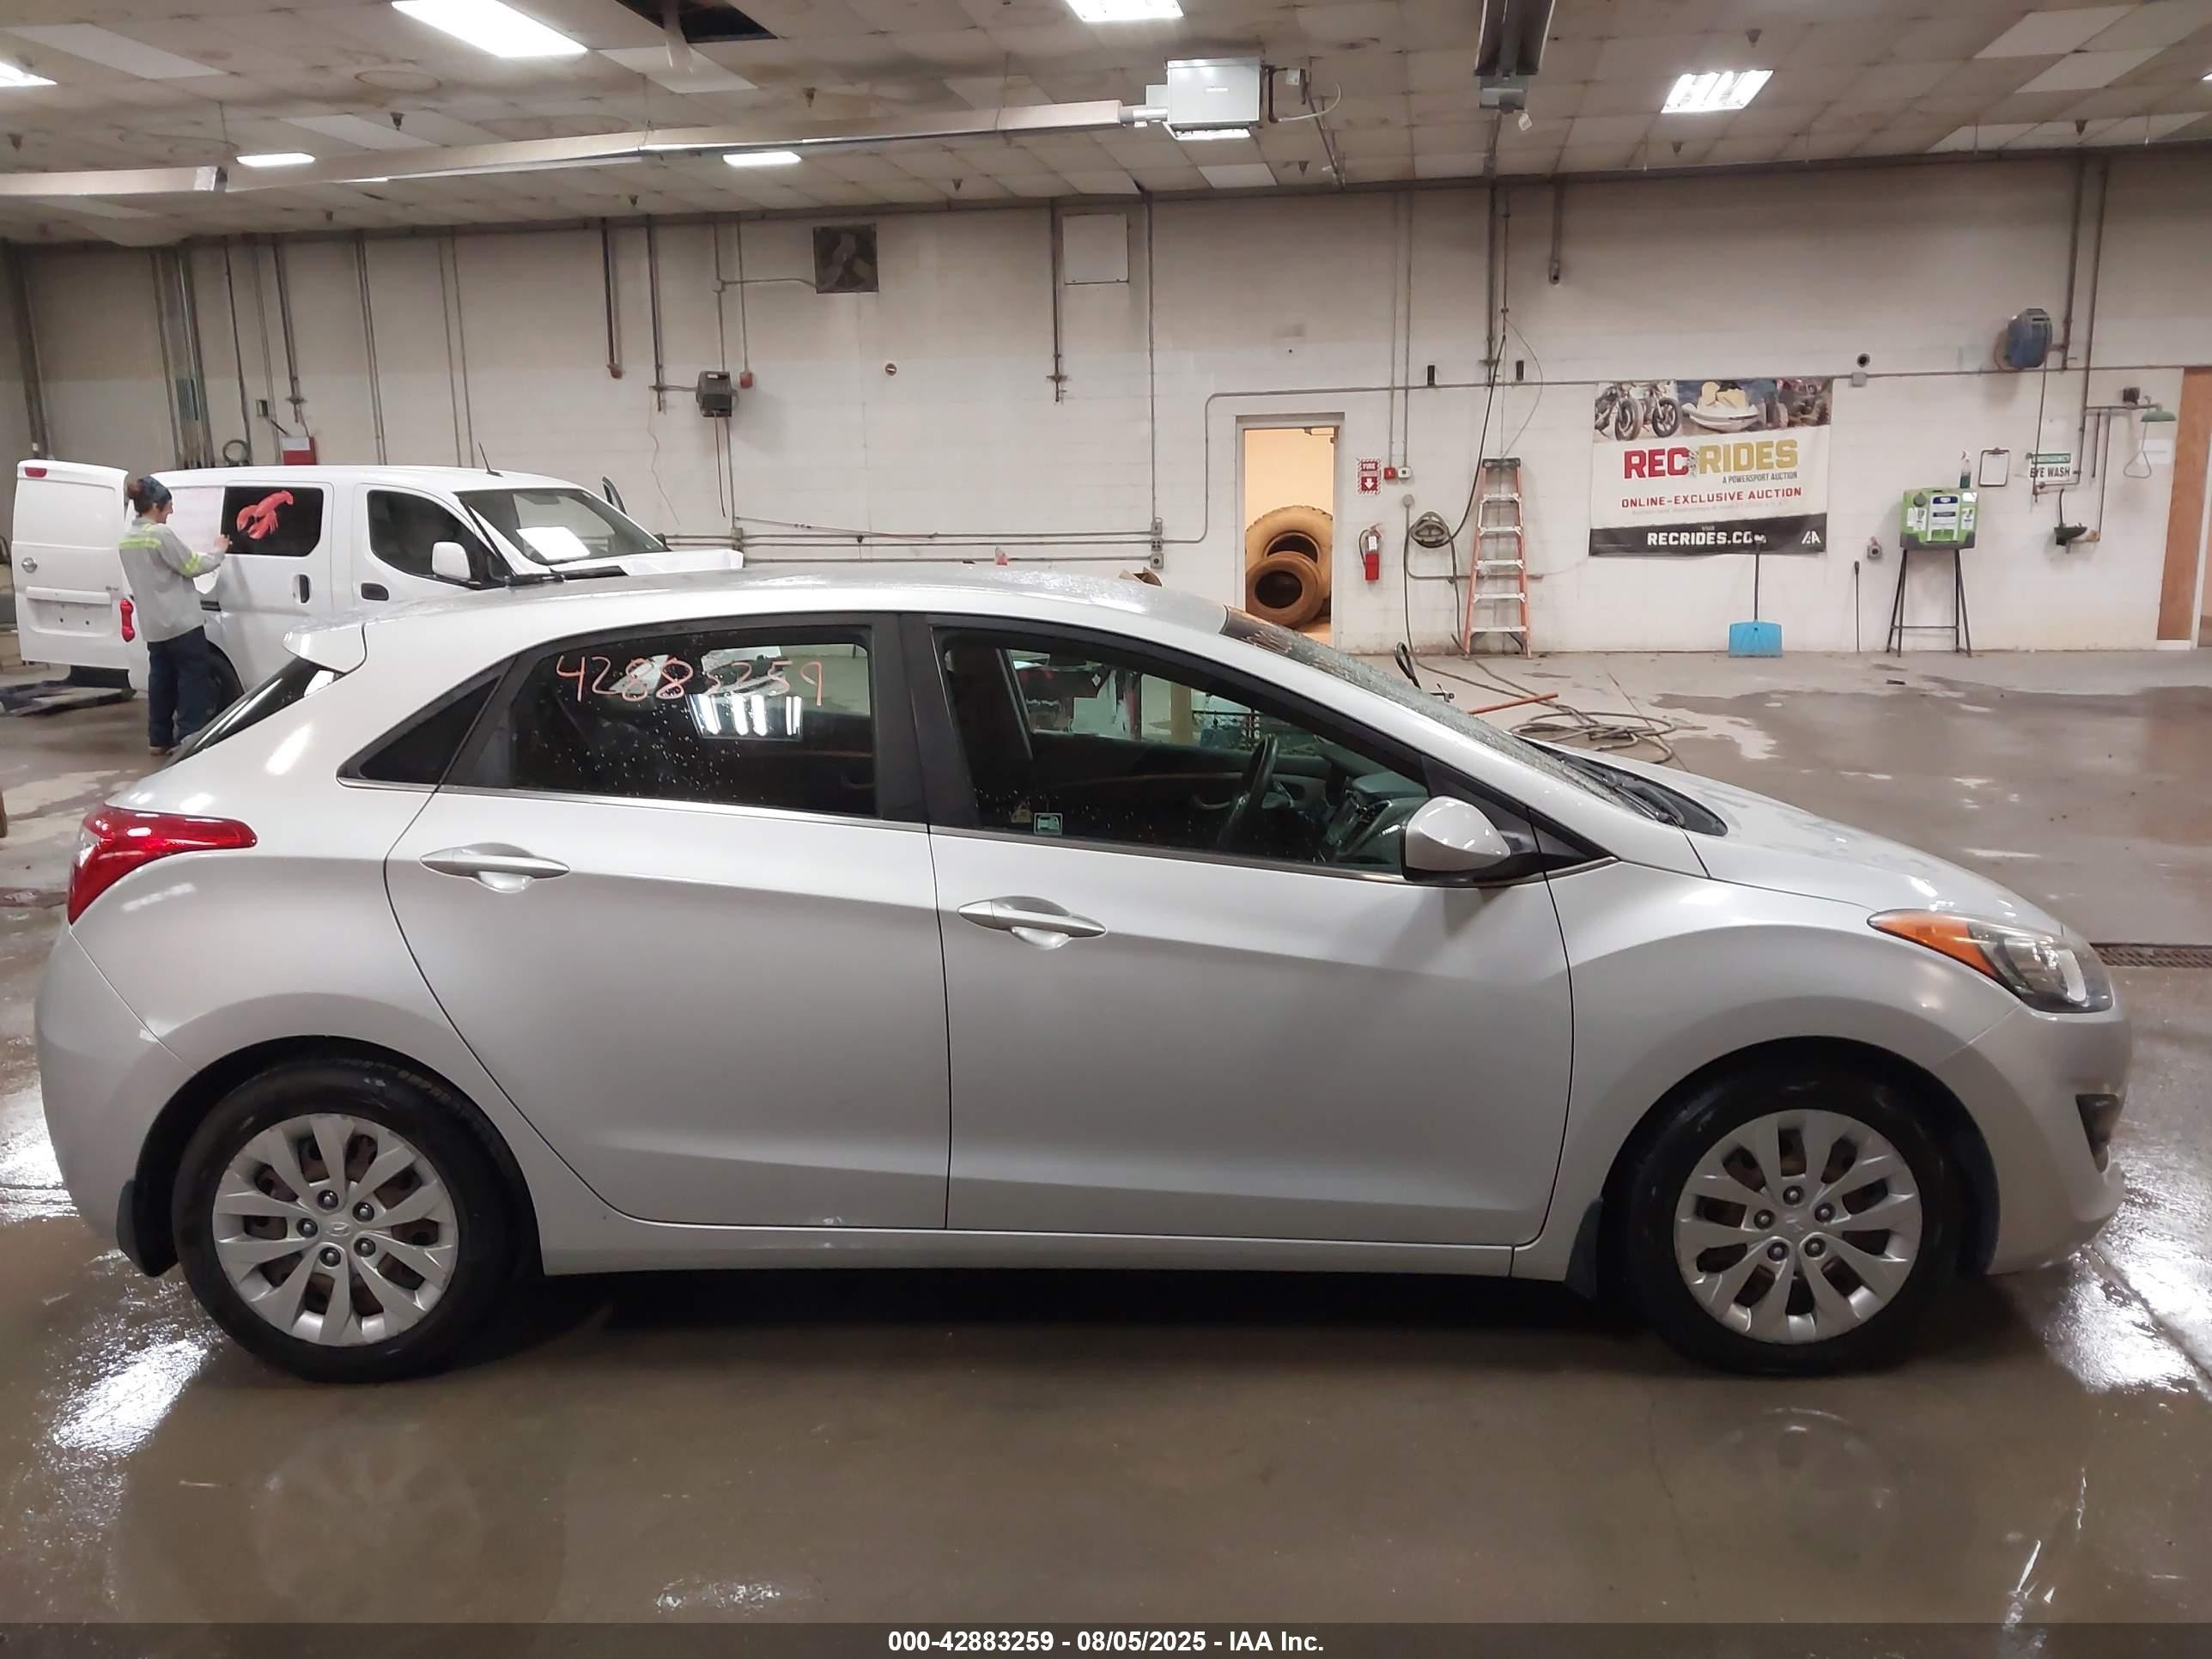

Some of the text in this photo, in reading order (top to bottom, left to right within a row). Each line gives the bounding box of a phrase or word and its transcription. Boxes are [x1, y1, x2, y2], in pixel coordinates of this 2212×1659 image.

[1624, 439, 1798, 479] REC RIDES
[1729, 474, 1769, 483] POWERSPORT
[1771, 471, 1797, 480] AUCTION
[2030, 466, 2070, 477] EYE WASH
[1621, 490, 1744, 508] ONLINE-EXCLUSIVE
[1748, 487, 1802, 500] AUCTION
